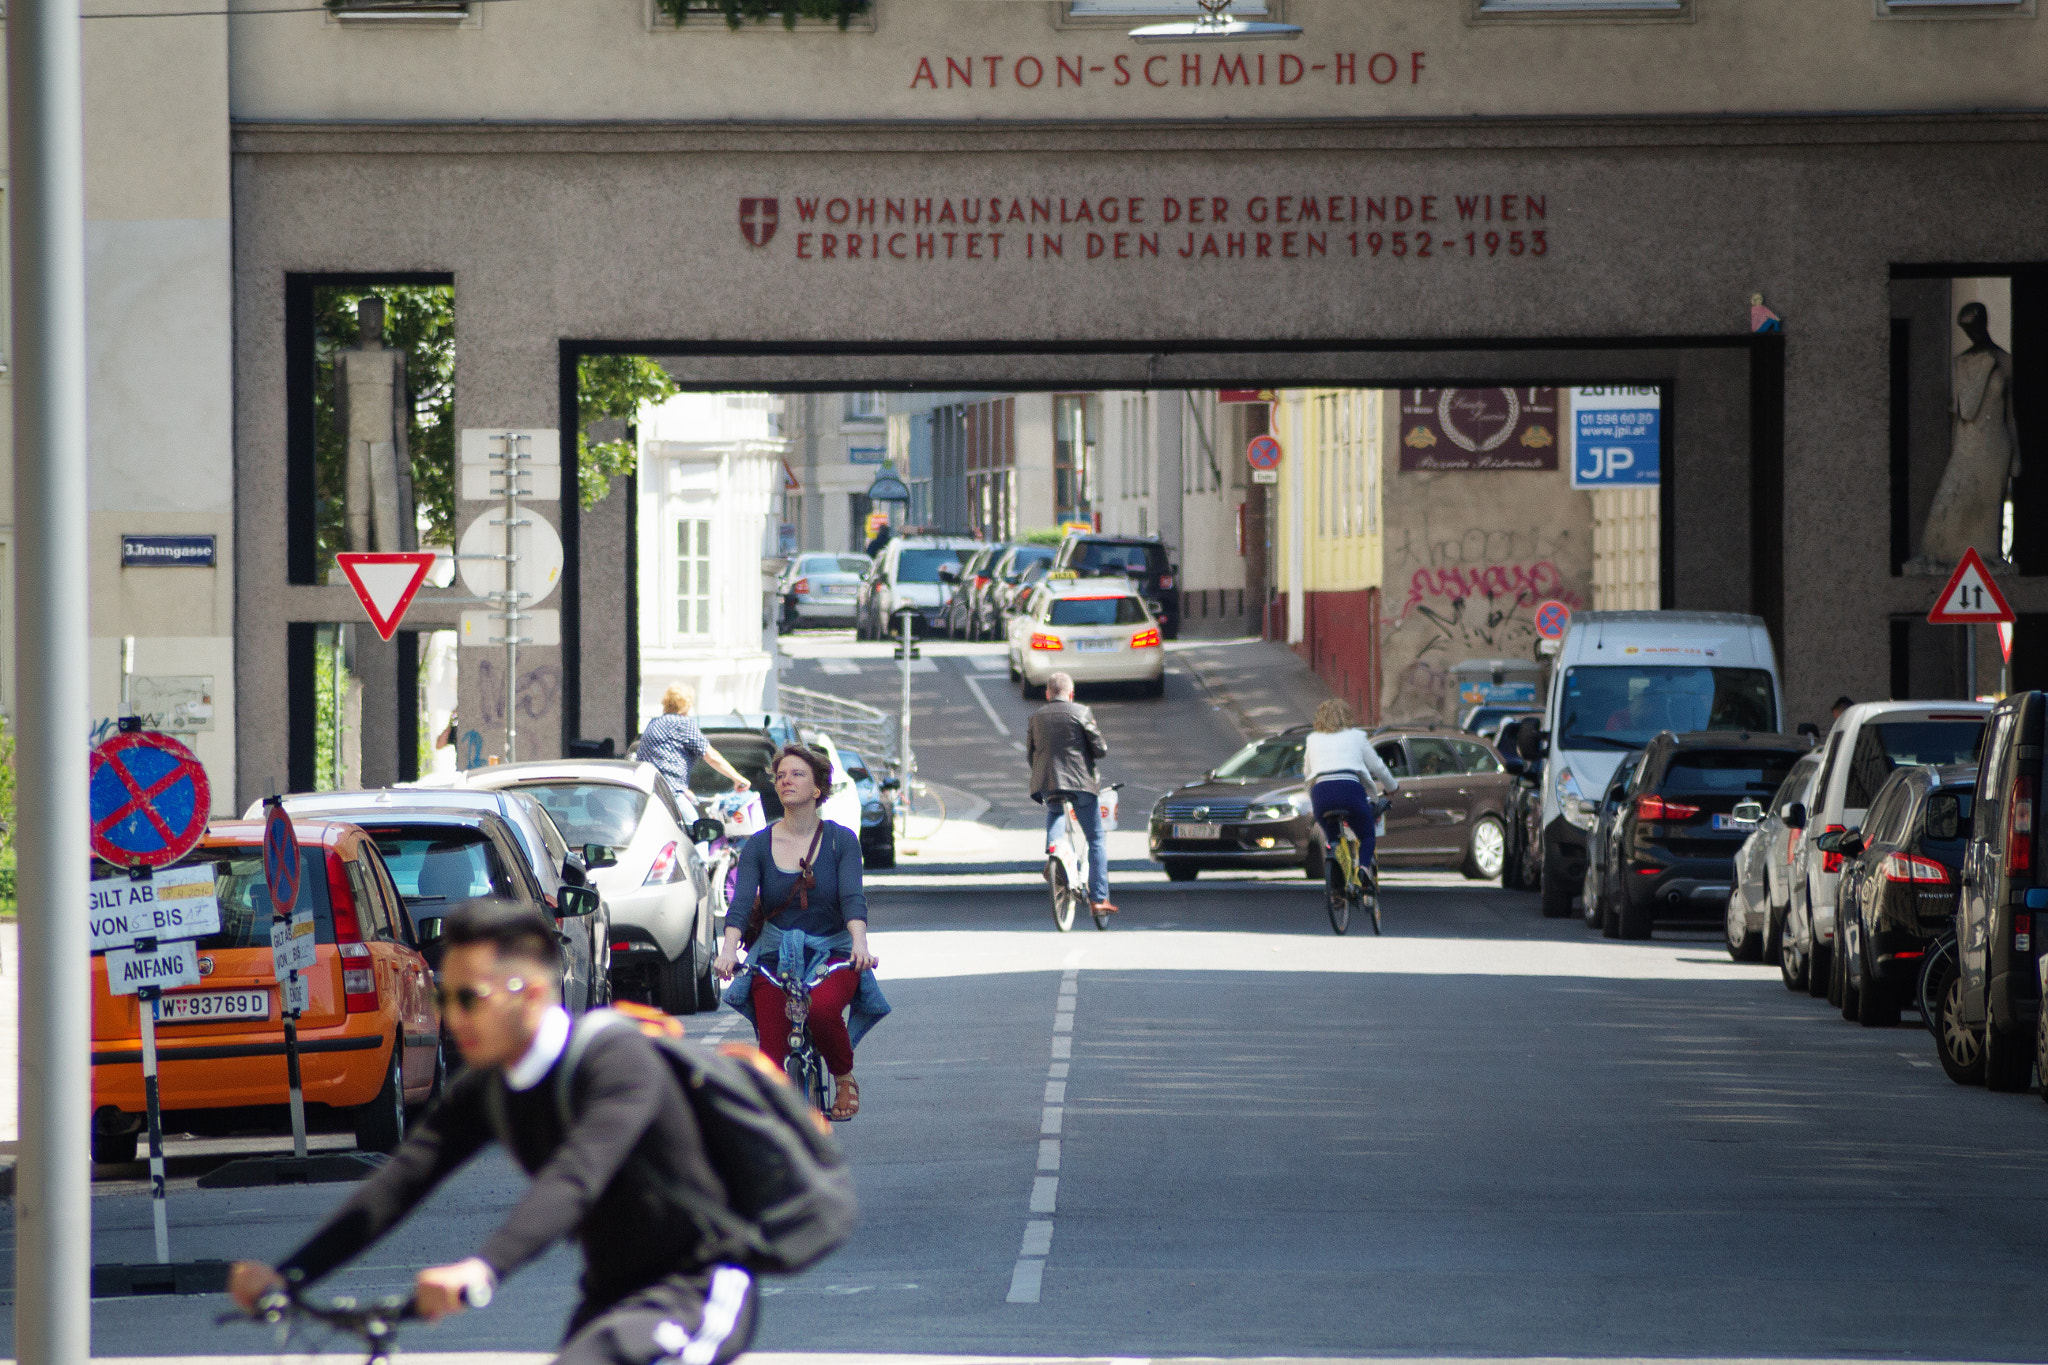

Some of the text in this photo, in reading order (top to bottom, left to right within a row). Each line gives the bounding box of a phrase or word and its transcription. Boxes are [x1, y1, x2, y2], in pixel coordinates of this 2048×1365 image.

[908, 52, 1428, 89] ANTON-SCHMID-HOF
[796, 194, 1547, 224] WOHNHAUSANLAGE DER GEMEINDE WIEN
[796, 230, 1548, 259] ERRICHTET IN DEN JAHREN 1952-1953
[1580, 447, 1635, 479] JP
[90, 889, 123, 911] GILT
[129, 885, 154, 905] AB
[90, 915, 129, 937] VON
[153, 908, 183, 928] BIS
[124, 955, 184, 981] ANFANG
[163, 999, 175, 1017] W
